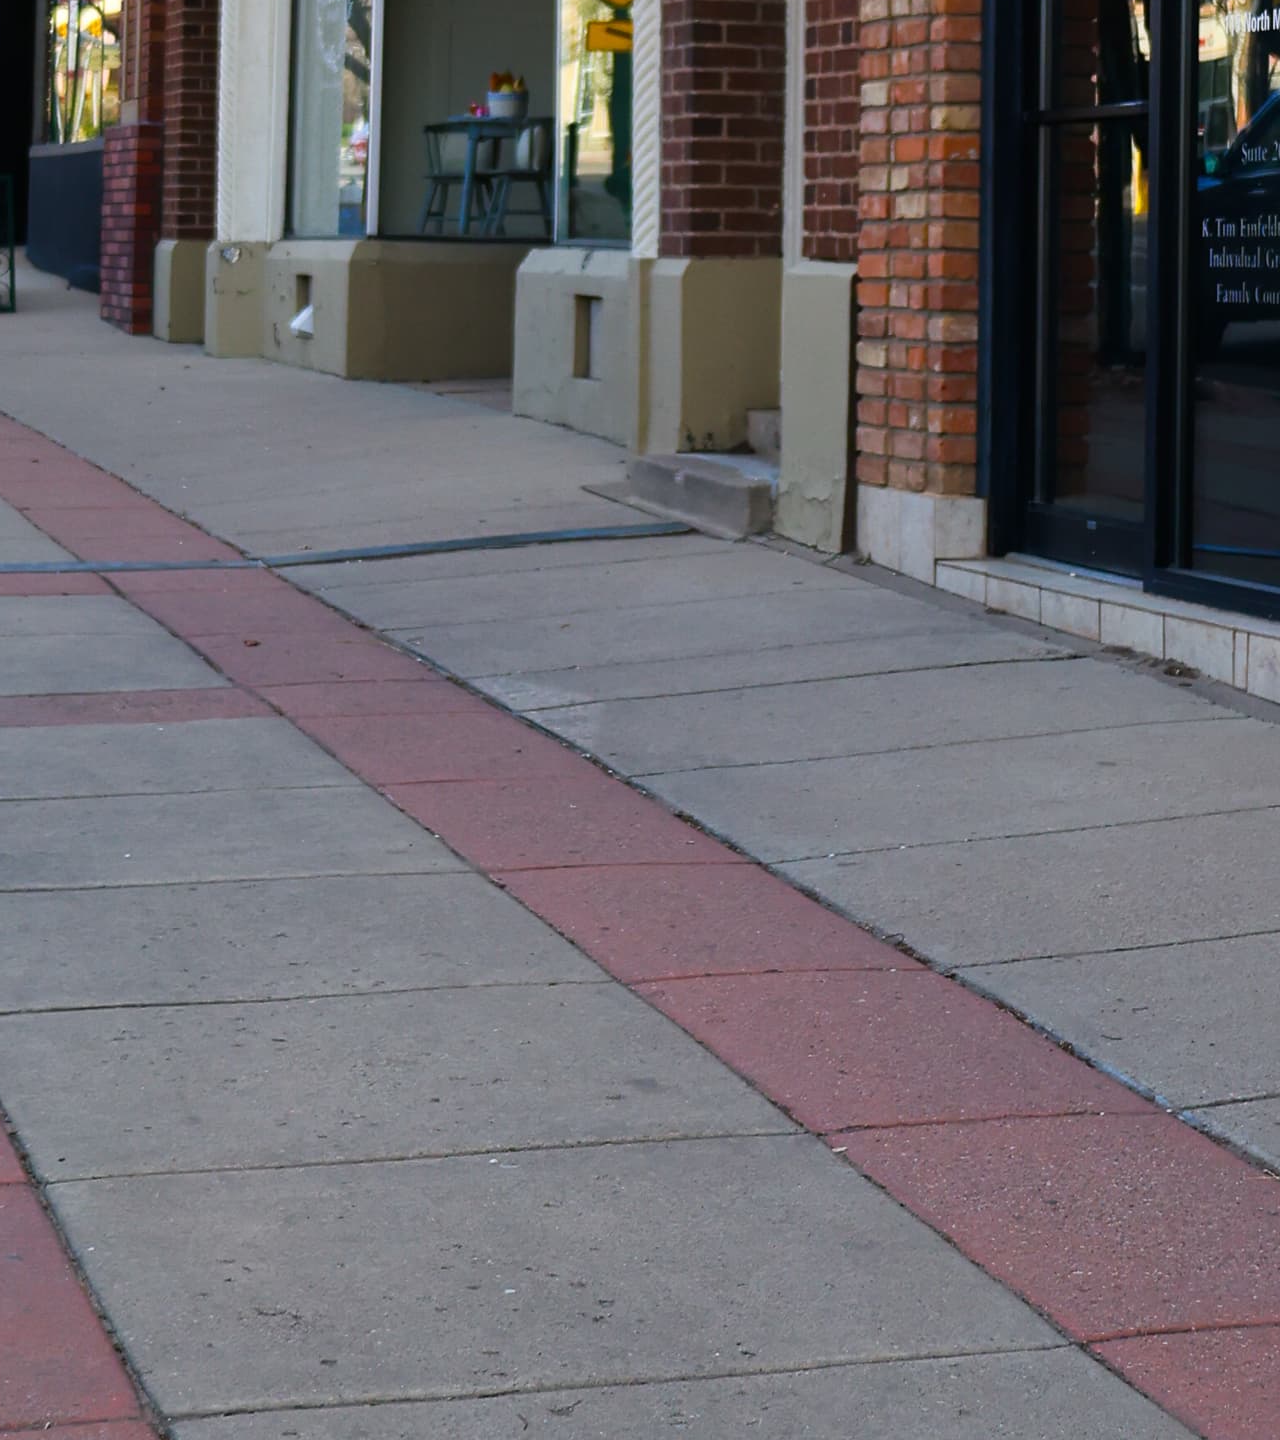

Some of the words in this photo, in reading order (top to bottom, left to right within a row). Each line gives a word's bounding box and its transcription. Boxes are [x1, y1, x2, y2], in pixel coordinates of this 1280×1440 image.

[1243, 9, 1271, 33] North
[1241, 142, 1268, 164] Suite
[1215, 217, 1236, 238] Tim
[1209, 245, 1261, 269] Individual
[1216, 281, 1250, 304] Family
